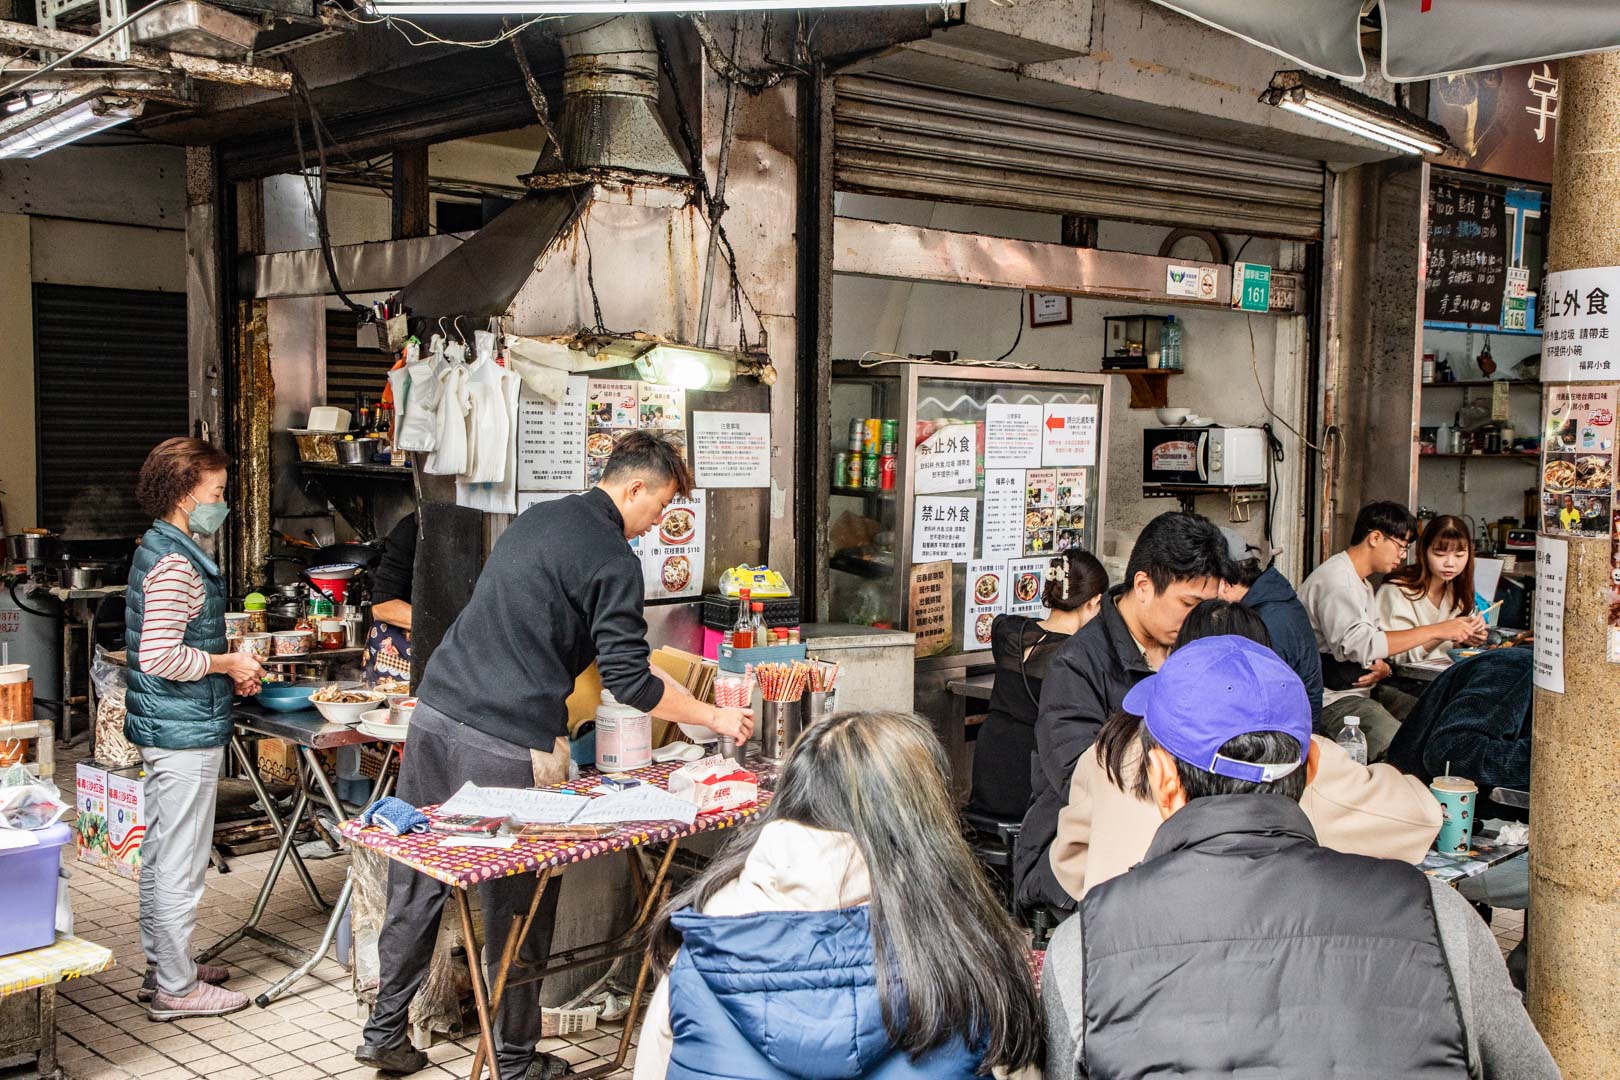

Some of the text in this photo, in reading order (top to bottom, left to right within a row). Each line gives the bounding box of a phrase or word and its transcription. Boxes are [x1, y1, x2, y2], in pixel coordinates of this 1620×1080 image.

[1247, 286, 1265, 303] 161
[1513, 283, 1526, 296] 105
[1510, 312, 1525, 327] 163
[1580, 328, 1609, 339] 請帶走
[1579, 360, 1611, 370] 福昇小食
[922, 505, 970, 522] 禁止外食
[0, 612, 20, 621] 876
[0, 623, 20, 632] 877
